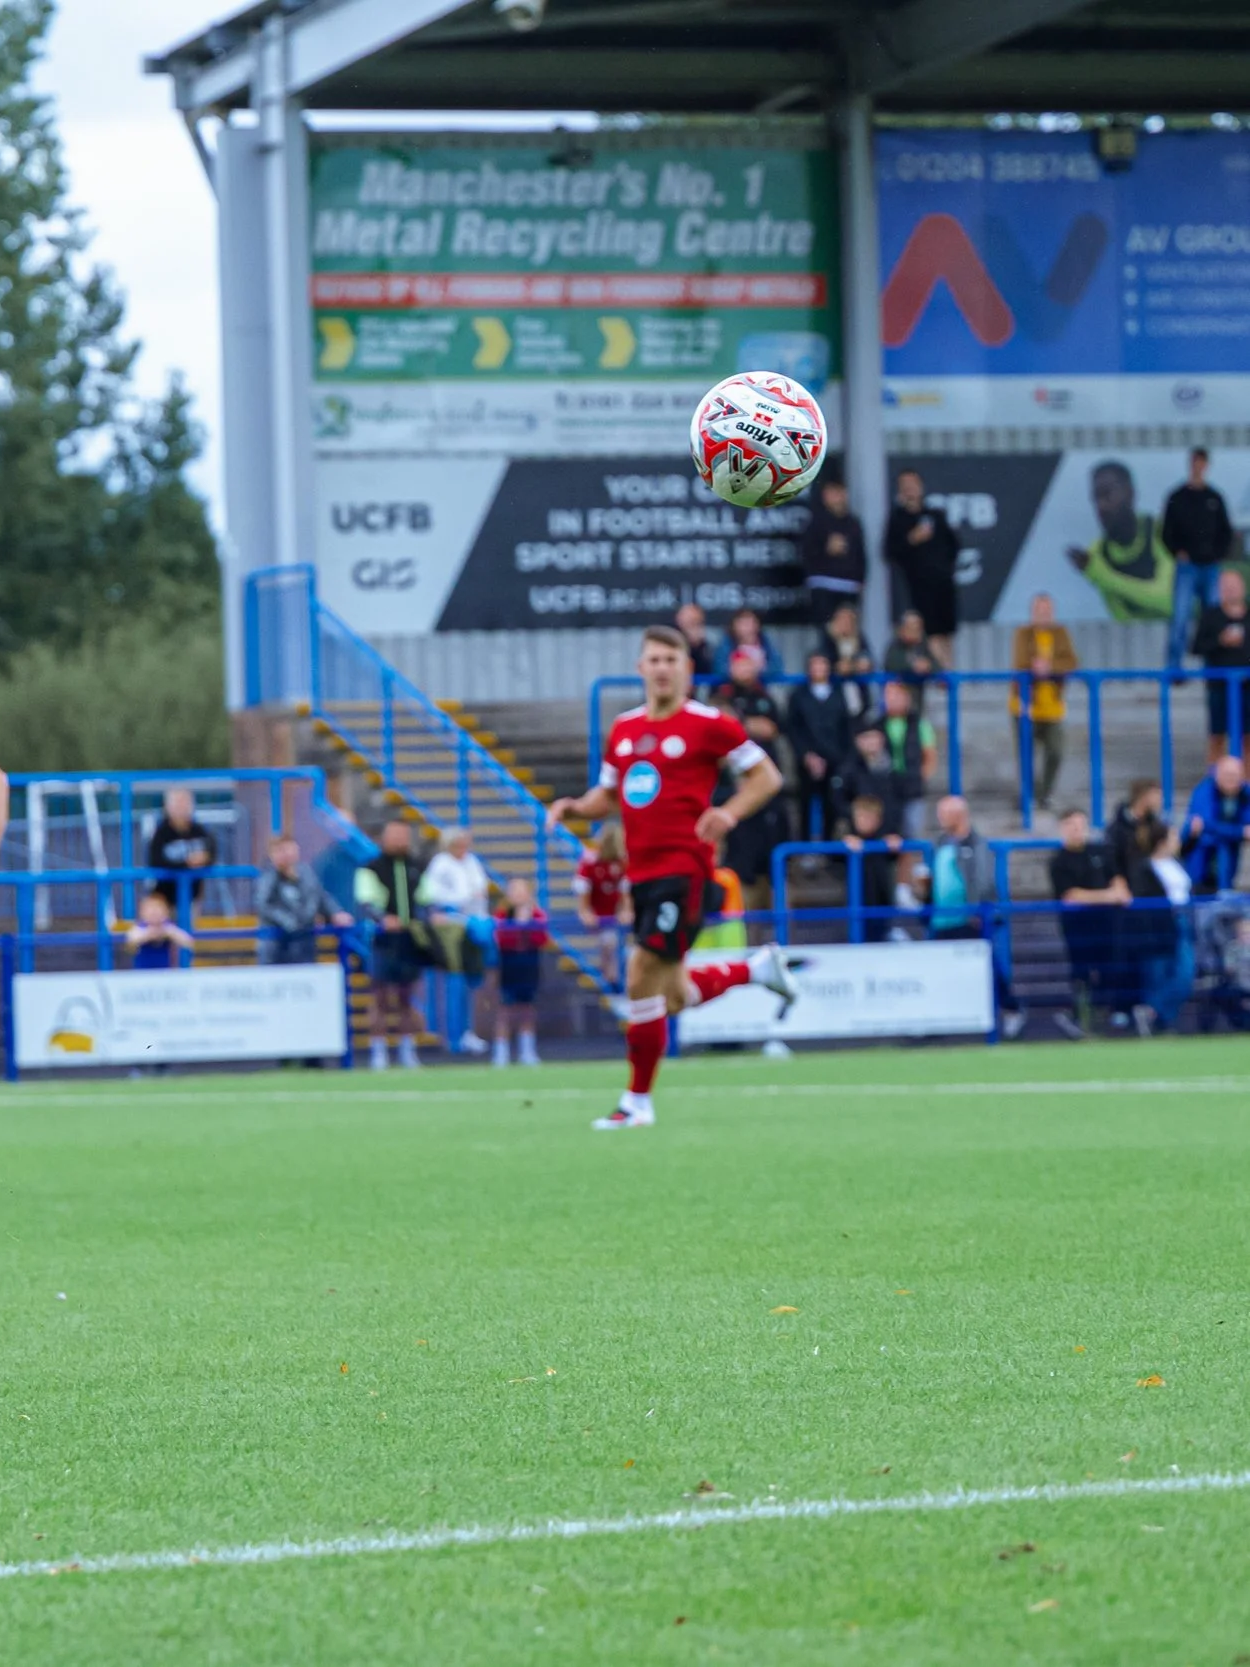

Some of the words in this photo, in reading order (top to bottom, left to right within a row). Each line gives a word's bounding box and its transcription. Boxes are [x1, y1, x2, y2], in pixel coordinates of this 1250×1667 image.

[359, 159, 646, 208] Manchester's
[657, 161, 725, 208] No.
[742, 162, 765, 207] 1
[313, 208, 446, 257] Metal
[452, 208, 665, 266] Recycling
[674, 211, 814, 258] Centre
[1124, 225, 1172, 255] AV
[735, 421, 781, 447] Mitre
[604, 475, 690, 503] YOUR
[331, 502, 434, 534] UCFB
[548, 508, 583, 536] IN
[587, 507, 742, 536] FOOTBALL
[745, 506, 812, 535] AND
[515, 541, 614, 572] SPORT
[619, 540, 730, 571] STARTS
[732, 538, 800, 569] HER
[351, 558, 419, 590] GIS
[529, 583, 677, 613] UCFB.ac.uk
